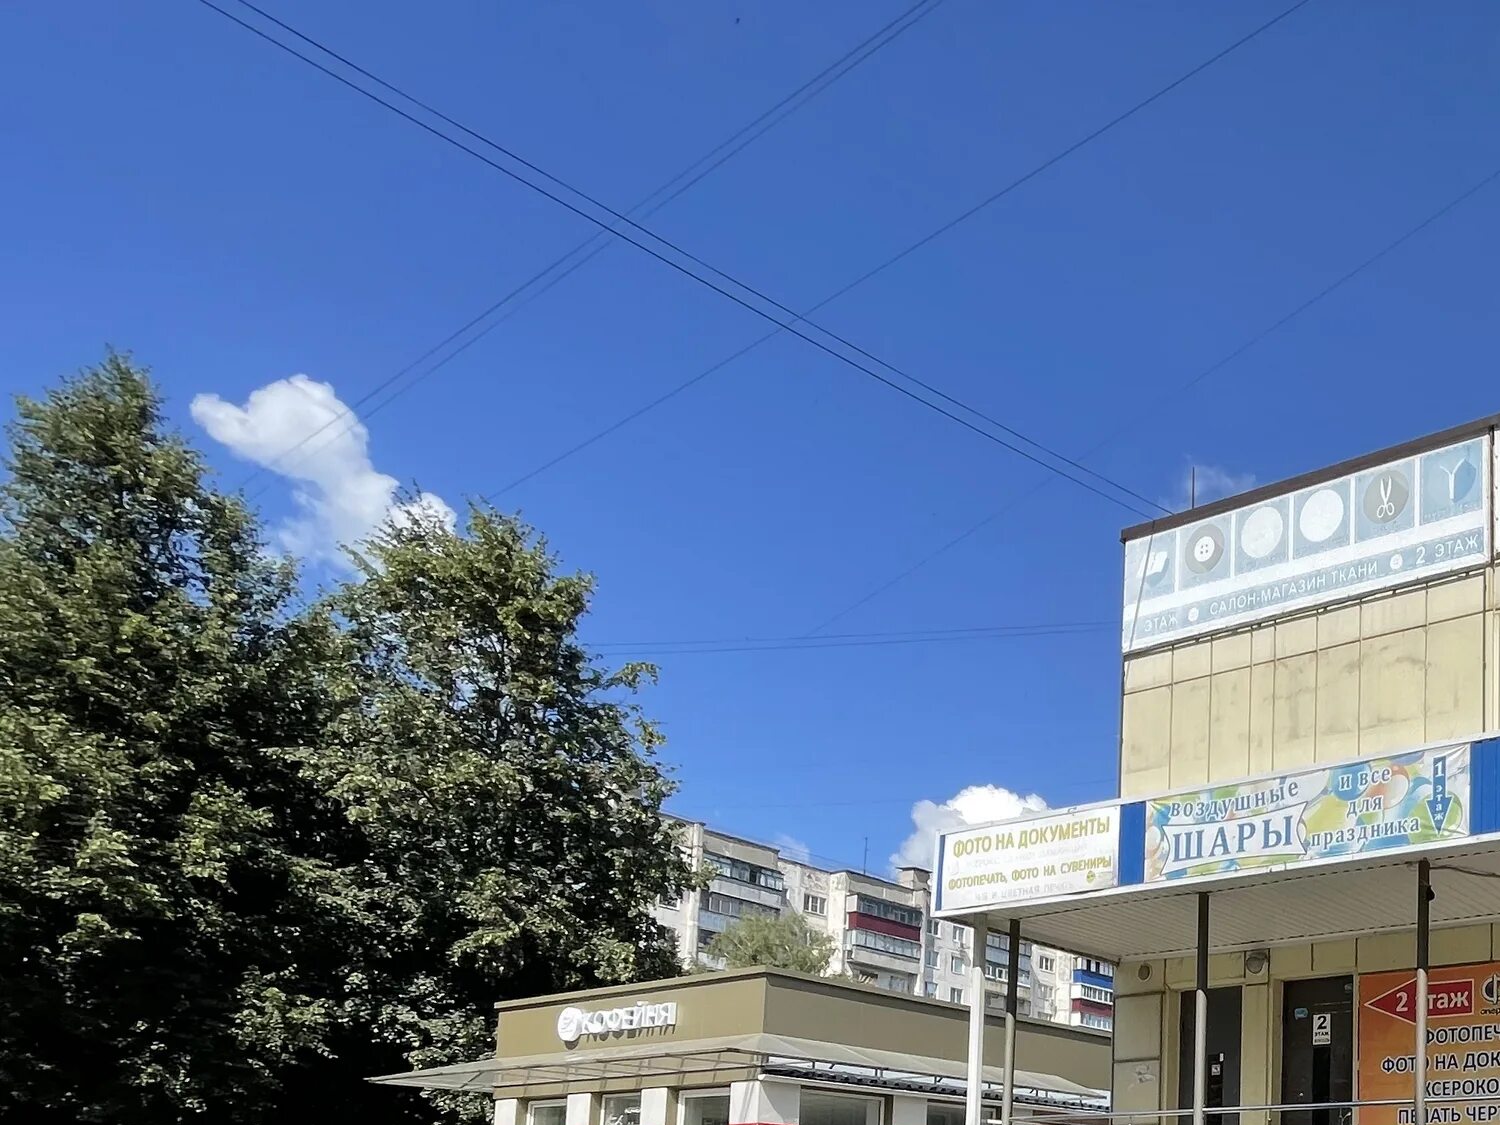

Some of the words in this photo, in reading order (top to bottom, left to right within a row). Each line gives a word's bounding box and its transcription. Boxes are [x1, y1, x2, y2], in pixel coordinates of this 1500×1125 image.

[1144, 614, 1178, 632] ЭТАЖ
[1210, 575, 1325, 616] САЛОН-МАГАЗИН
[1331, 561, 1378, 585] ТКАНИ
[1415, 548, 1426, 565] 2
[1434, 534, 1480, 557] ЭТАЖ
[1339, 775, 1351, 791] и
[1358, 767, 1391, 785] все
[1435, 762, 1444, 777] 1
[953, 835, 992, 858] ФОТО
[995, 832, 1015, 849] НА
[1018, 816, 1110, 849] ДОКУМЕНТЫ
[1172, 815, 1293, 862] ШАРЫ
[1347, 796, 1383, 818] для
[1311, 815, 1421, 850] праздника
[948, 872, 1008, 890] ФОТОПЕЧАТЬ,
[1011, 867, 1039, 882] ФОТО
[1043, 864, 1056, 877] НА
[1060, 856, 1111, 874] СУВЕНИРЫ
[1396, 992, 1408, 1012] 2
[1415, 990, 1469, 1010] таж
[581, 1001, 677, 1035] КОФЕЙНЯ
[1317, 1016, 1327, 1030] 2
[1435, 1054, 1458, 1070] НА
[1398, 1107, 1461, 1124] ПЕАТЬ
